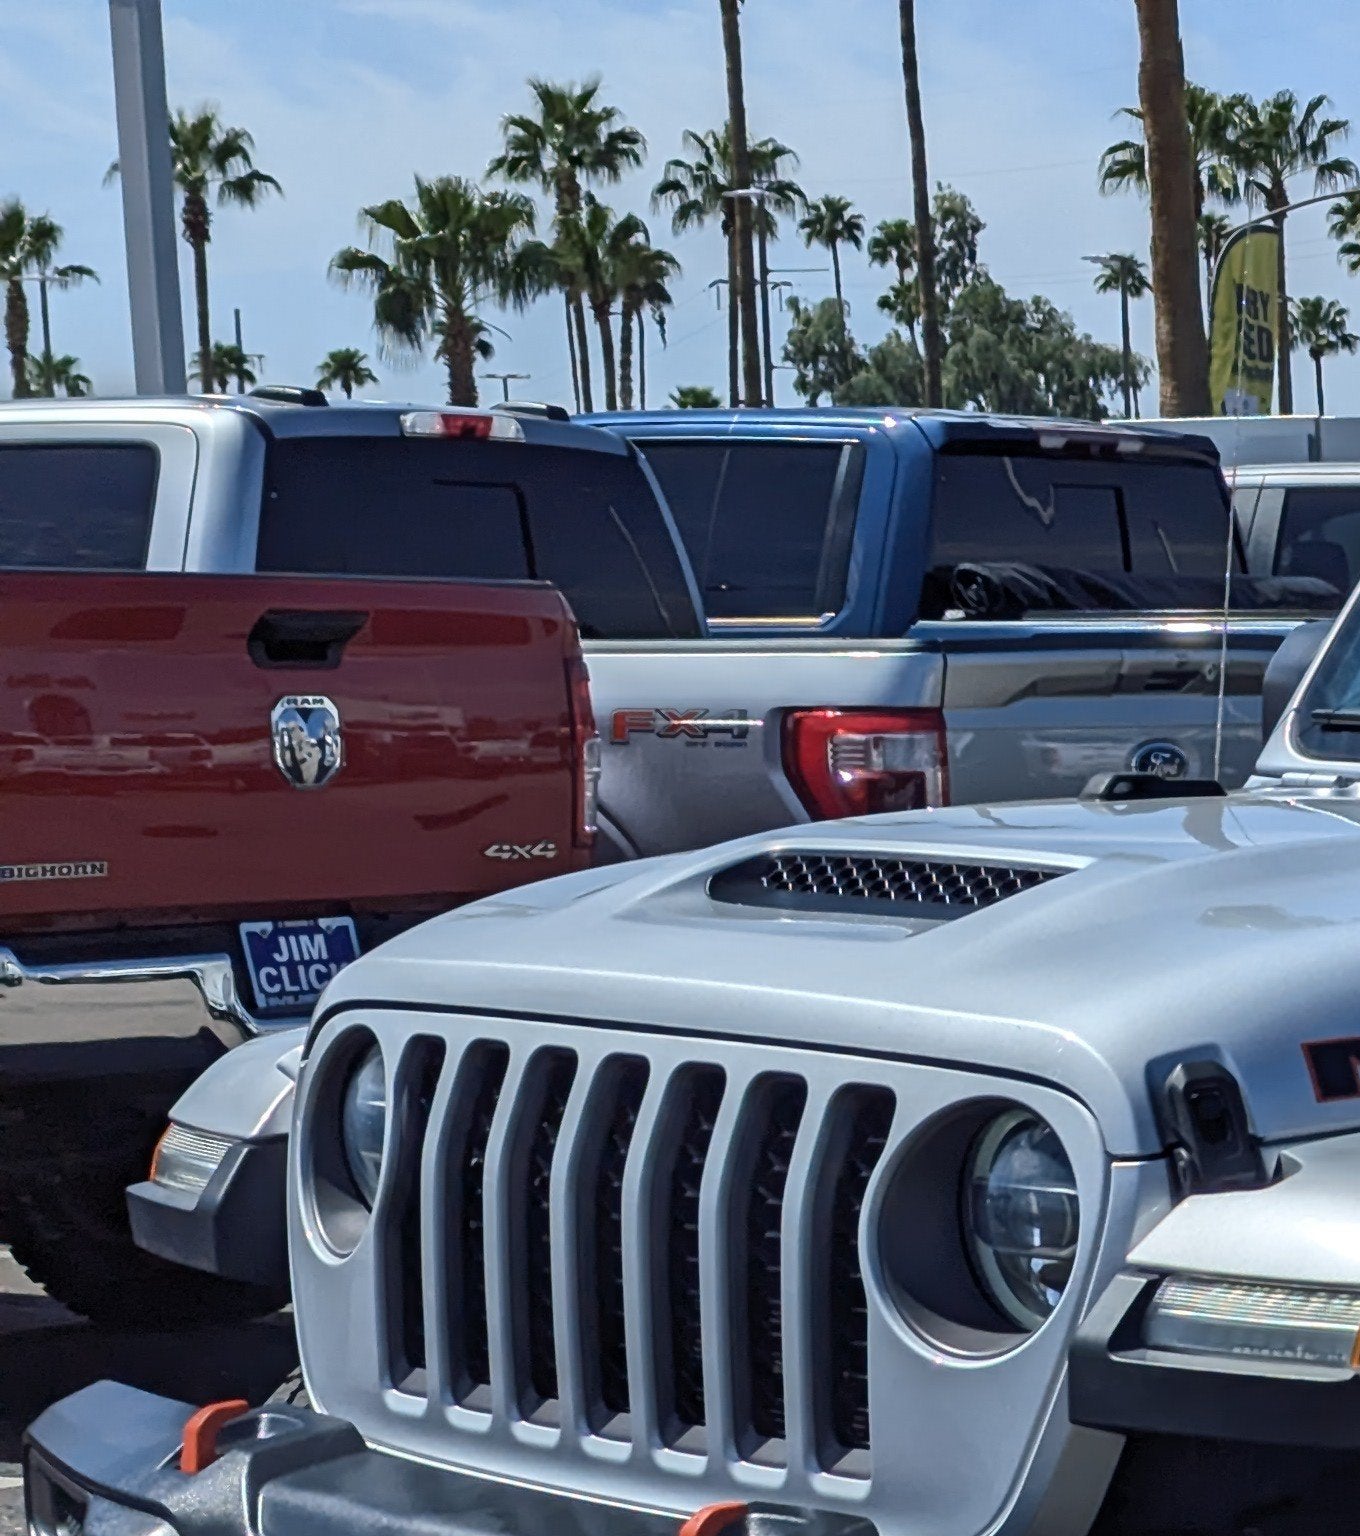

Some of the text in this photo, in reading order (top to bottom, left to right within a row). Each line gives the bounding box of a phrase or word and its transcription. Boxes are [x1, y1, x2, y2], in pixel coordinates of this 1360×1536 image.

[285, 697, 325, 706] RAM
[610, 708, 750, 745] FX4
[272, 933, 329, 962] JIM
